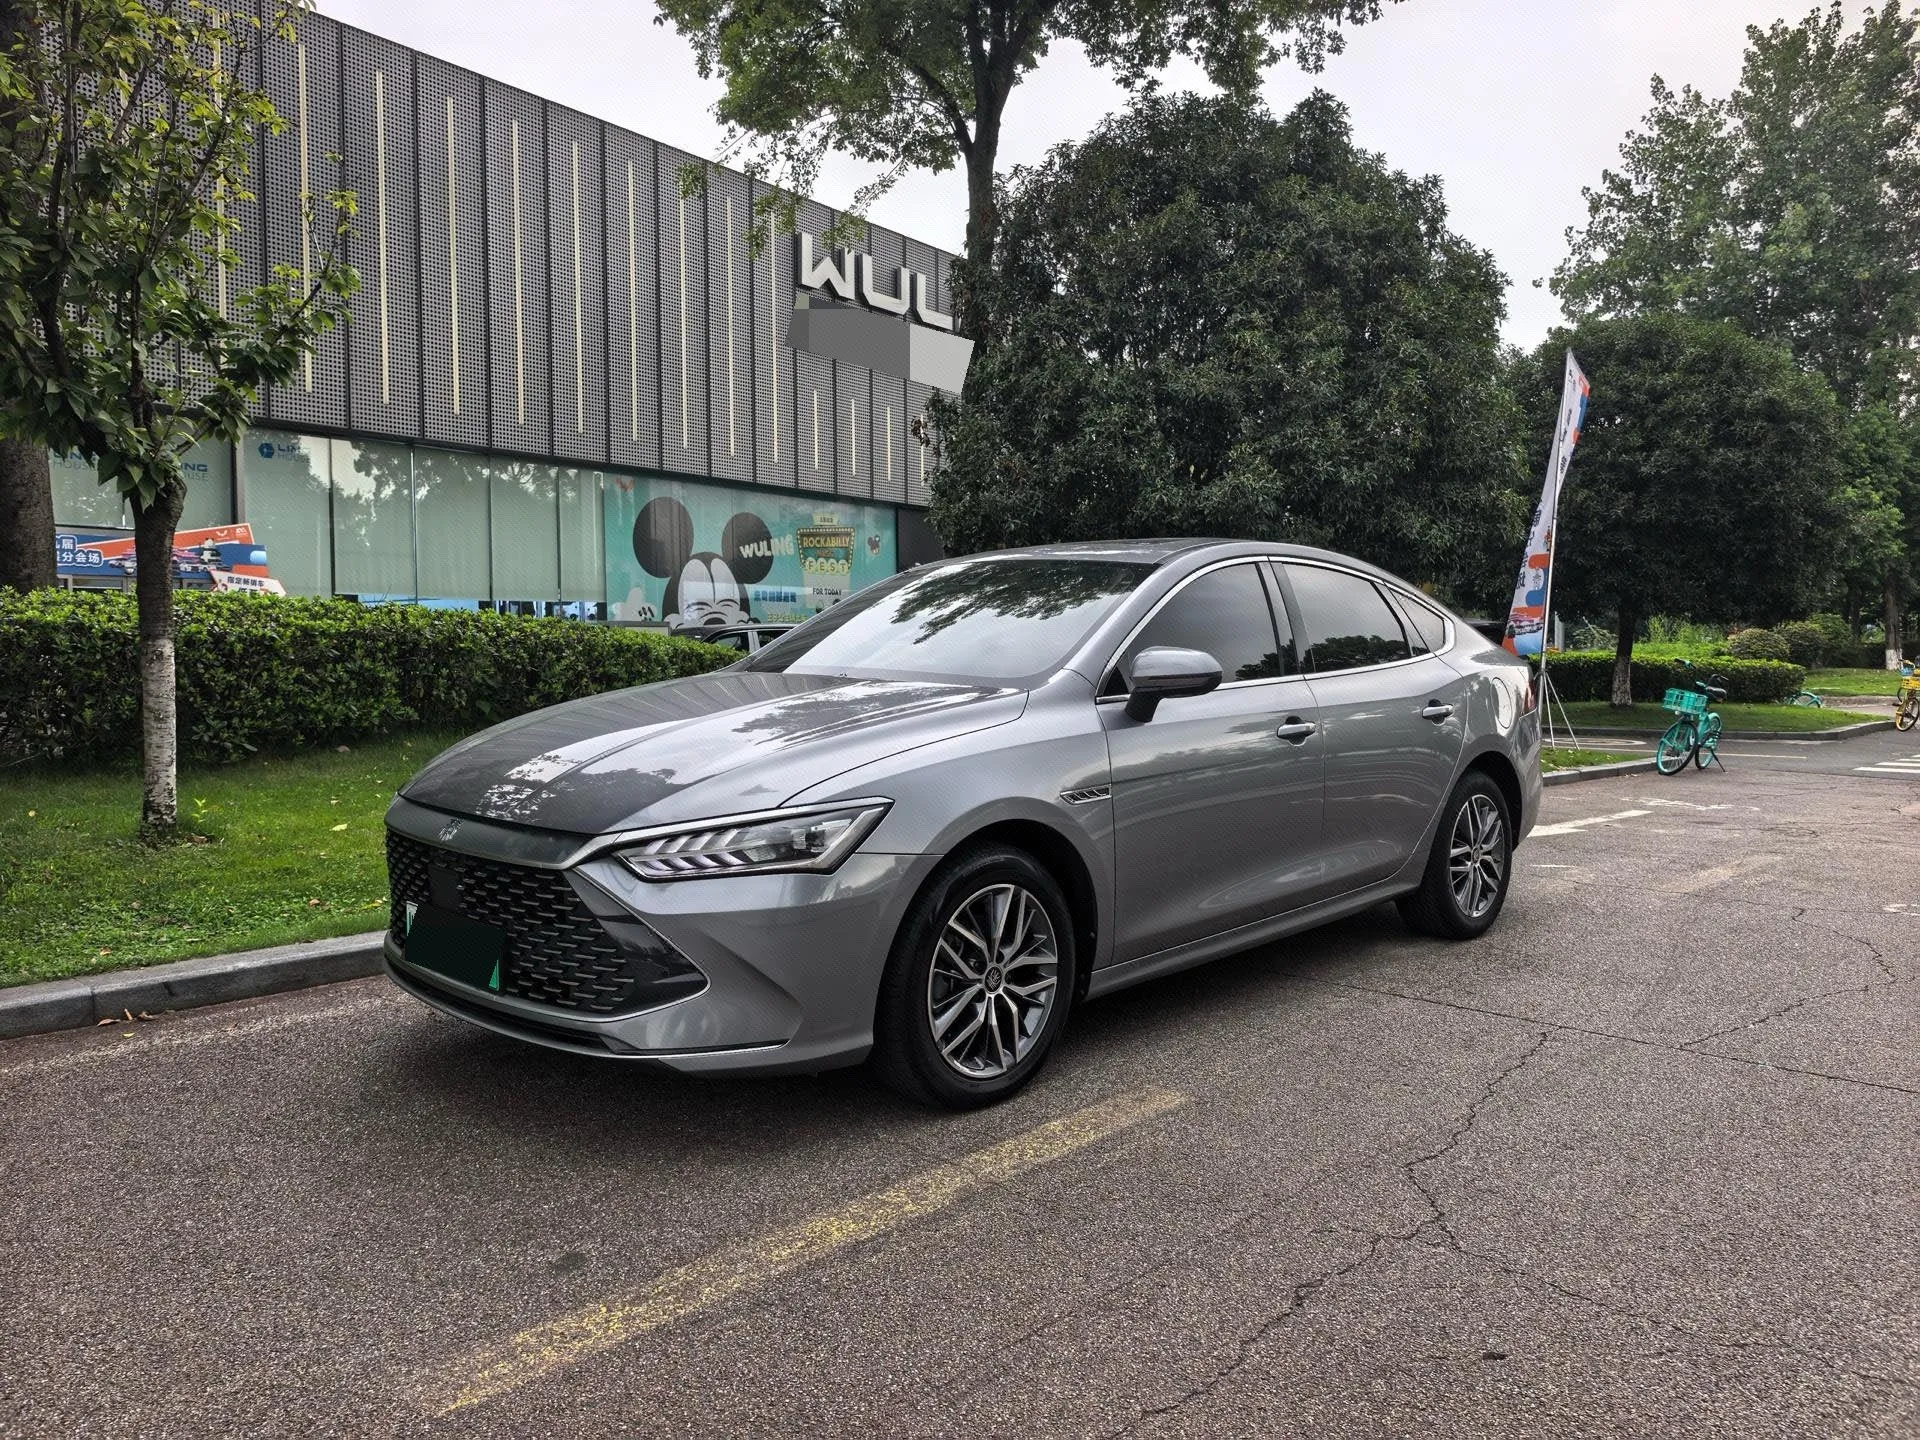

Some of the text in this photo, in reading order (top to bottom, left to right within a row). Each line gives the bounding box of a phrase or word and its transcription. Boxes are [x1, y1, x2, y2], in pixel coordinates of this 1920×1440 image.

[799, 231, 962, 334] WUL
[739, 535, 794, 558] WULING
[803, 536, 849, 548] ROCKABILLY
[808, 560, 847, 573] FEST
[812, 587, 842, 596] FOR TODAY
